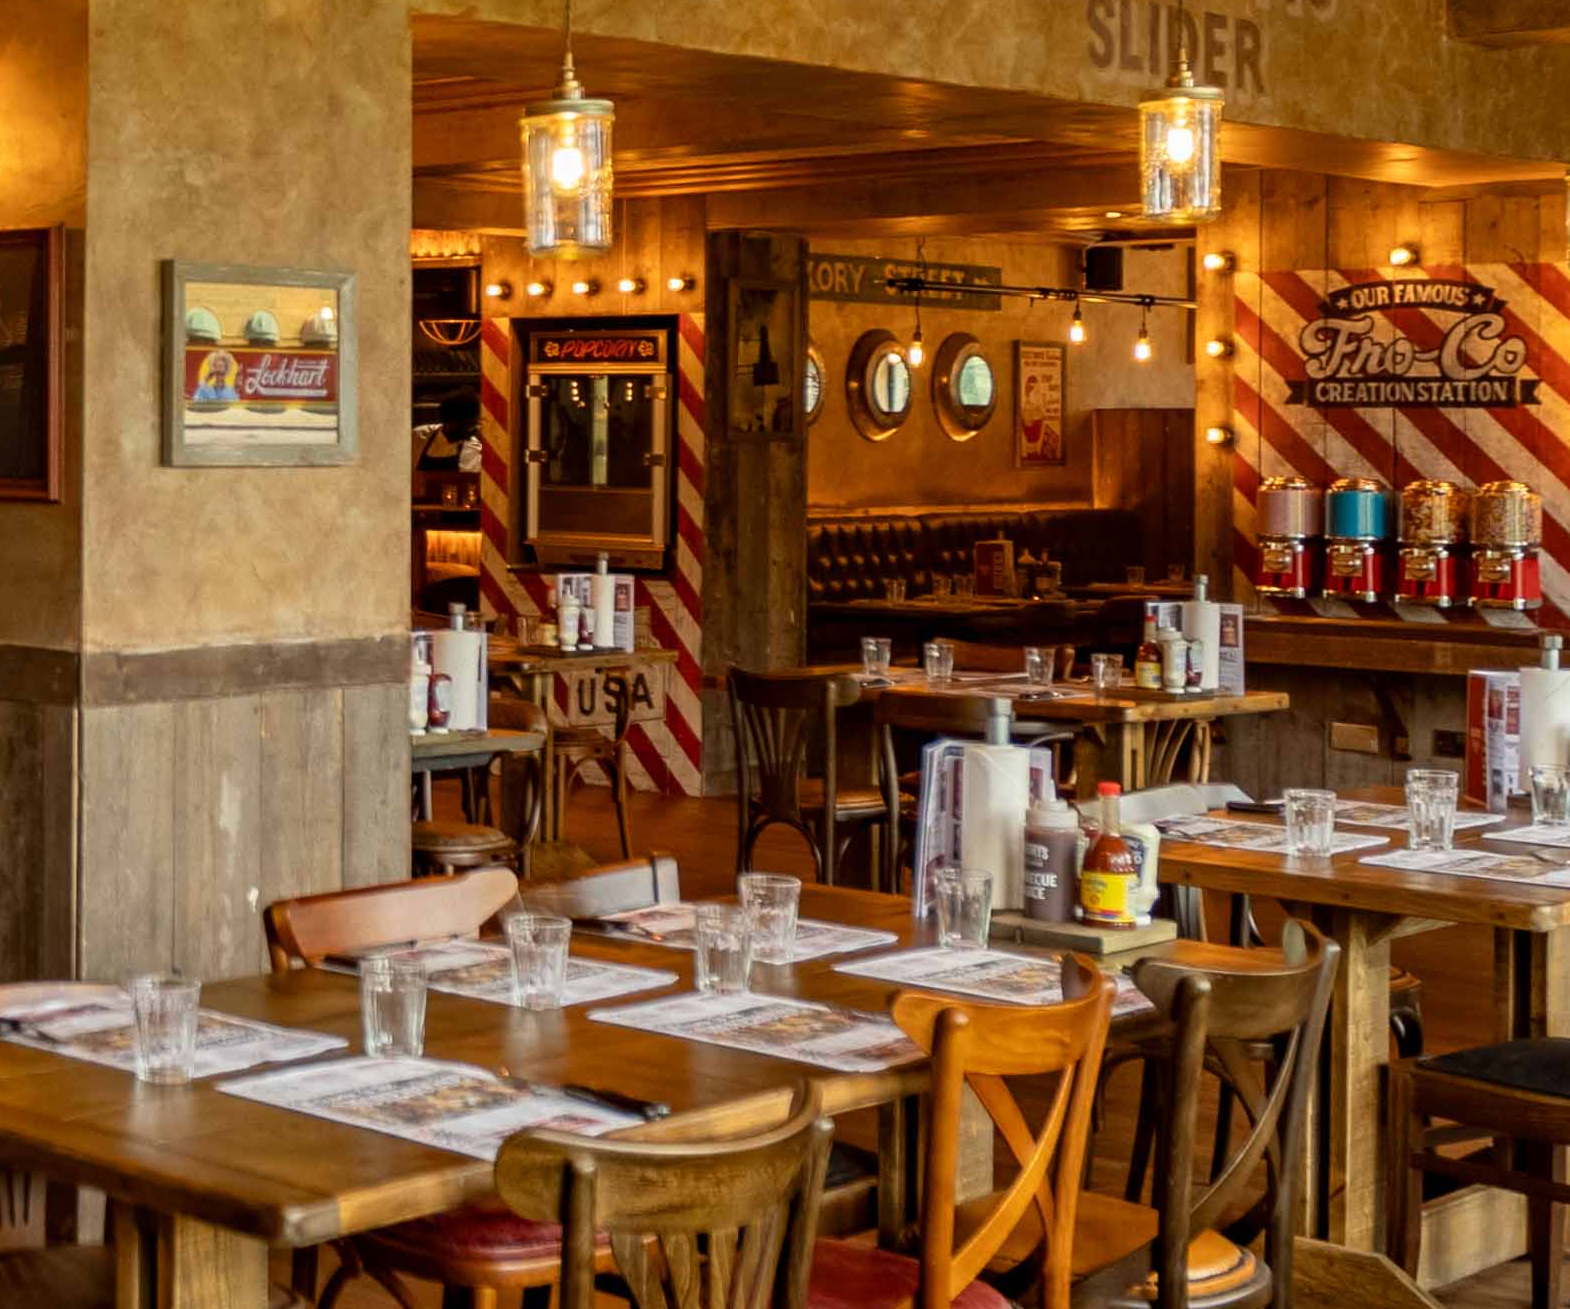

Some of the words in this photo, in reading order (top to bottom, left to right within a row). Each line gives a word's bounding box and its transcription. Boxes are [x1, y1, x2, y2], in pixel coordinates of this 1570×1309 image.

[808, 259, 866, 293] KORY
[1349, 287, 1391, 308] OUR
[1393, 283, 1468, 307] FAMOUS
[245, 354, 330, 396] Lockhart
[1315, 381, 1414, 403] CREATION
[1416, 380, 1509, 403] STATION
[577, 672, 655, 717] USA
